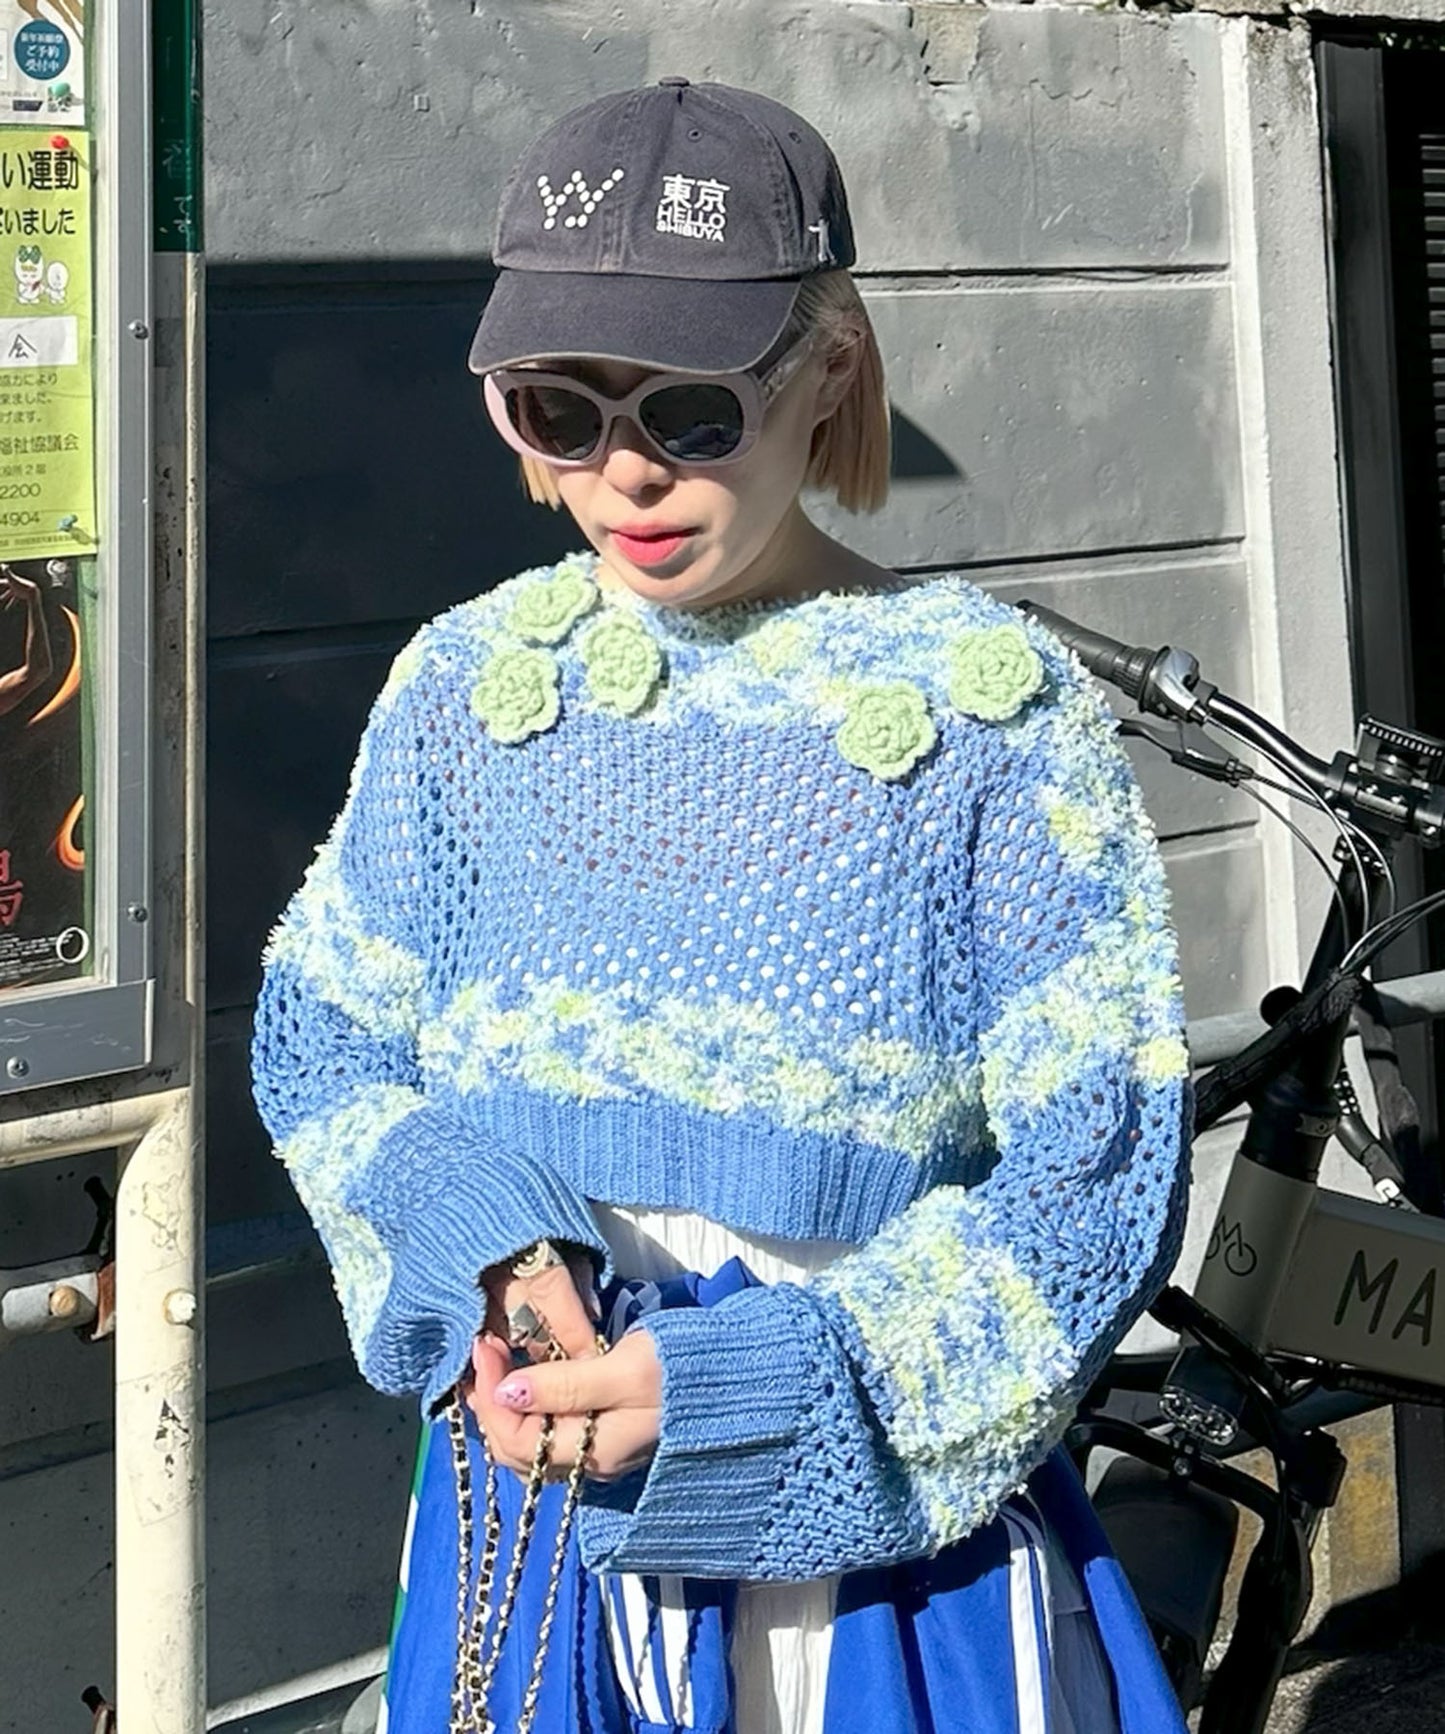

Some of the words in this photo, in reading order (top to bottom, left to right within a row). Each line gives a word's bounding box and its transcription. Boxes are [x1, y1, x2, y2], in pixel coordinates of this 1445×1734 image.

[2, 150, 79, 190] い運動
[660, 174, 731, 214] 東京
[0, 206, 76, 236] いました
[656, 219, 725, 242] SHIBUYA
[657, 204, 726, 230] HELLO
[0, 483, 41, 499] 2200
